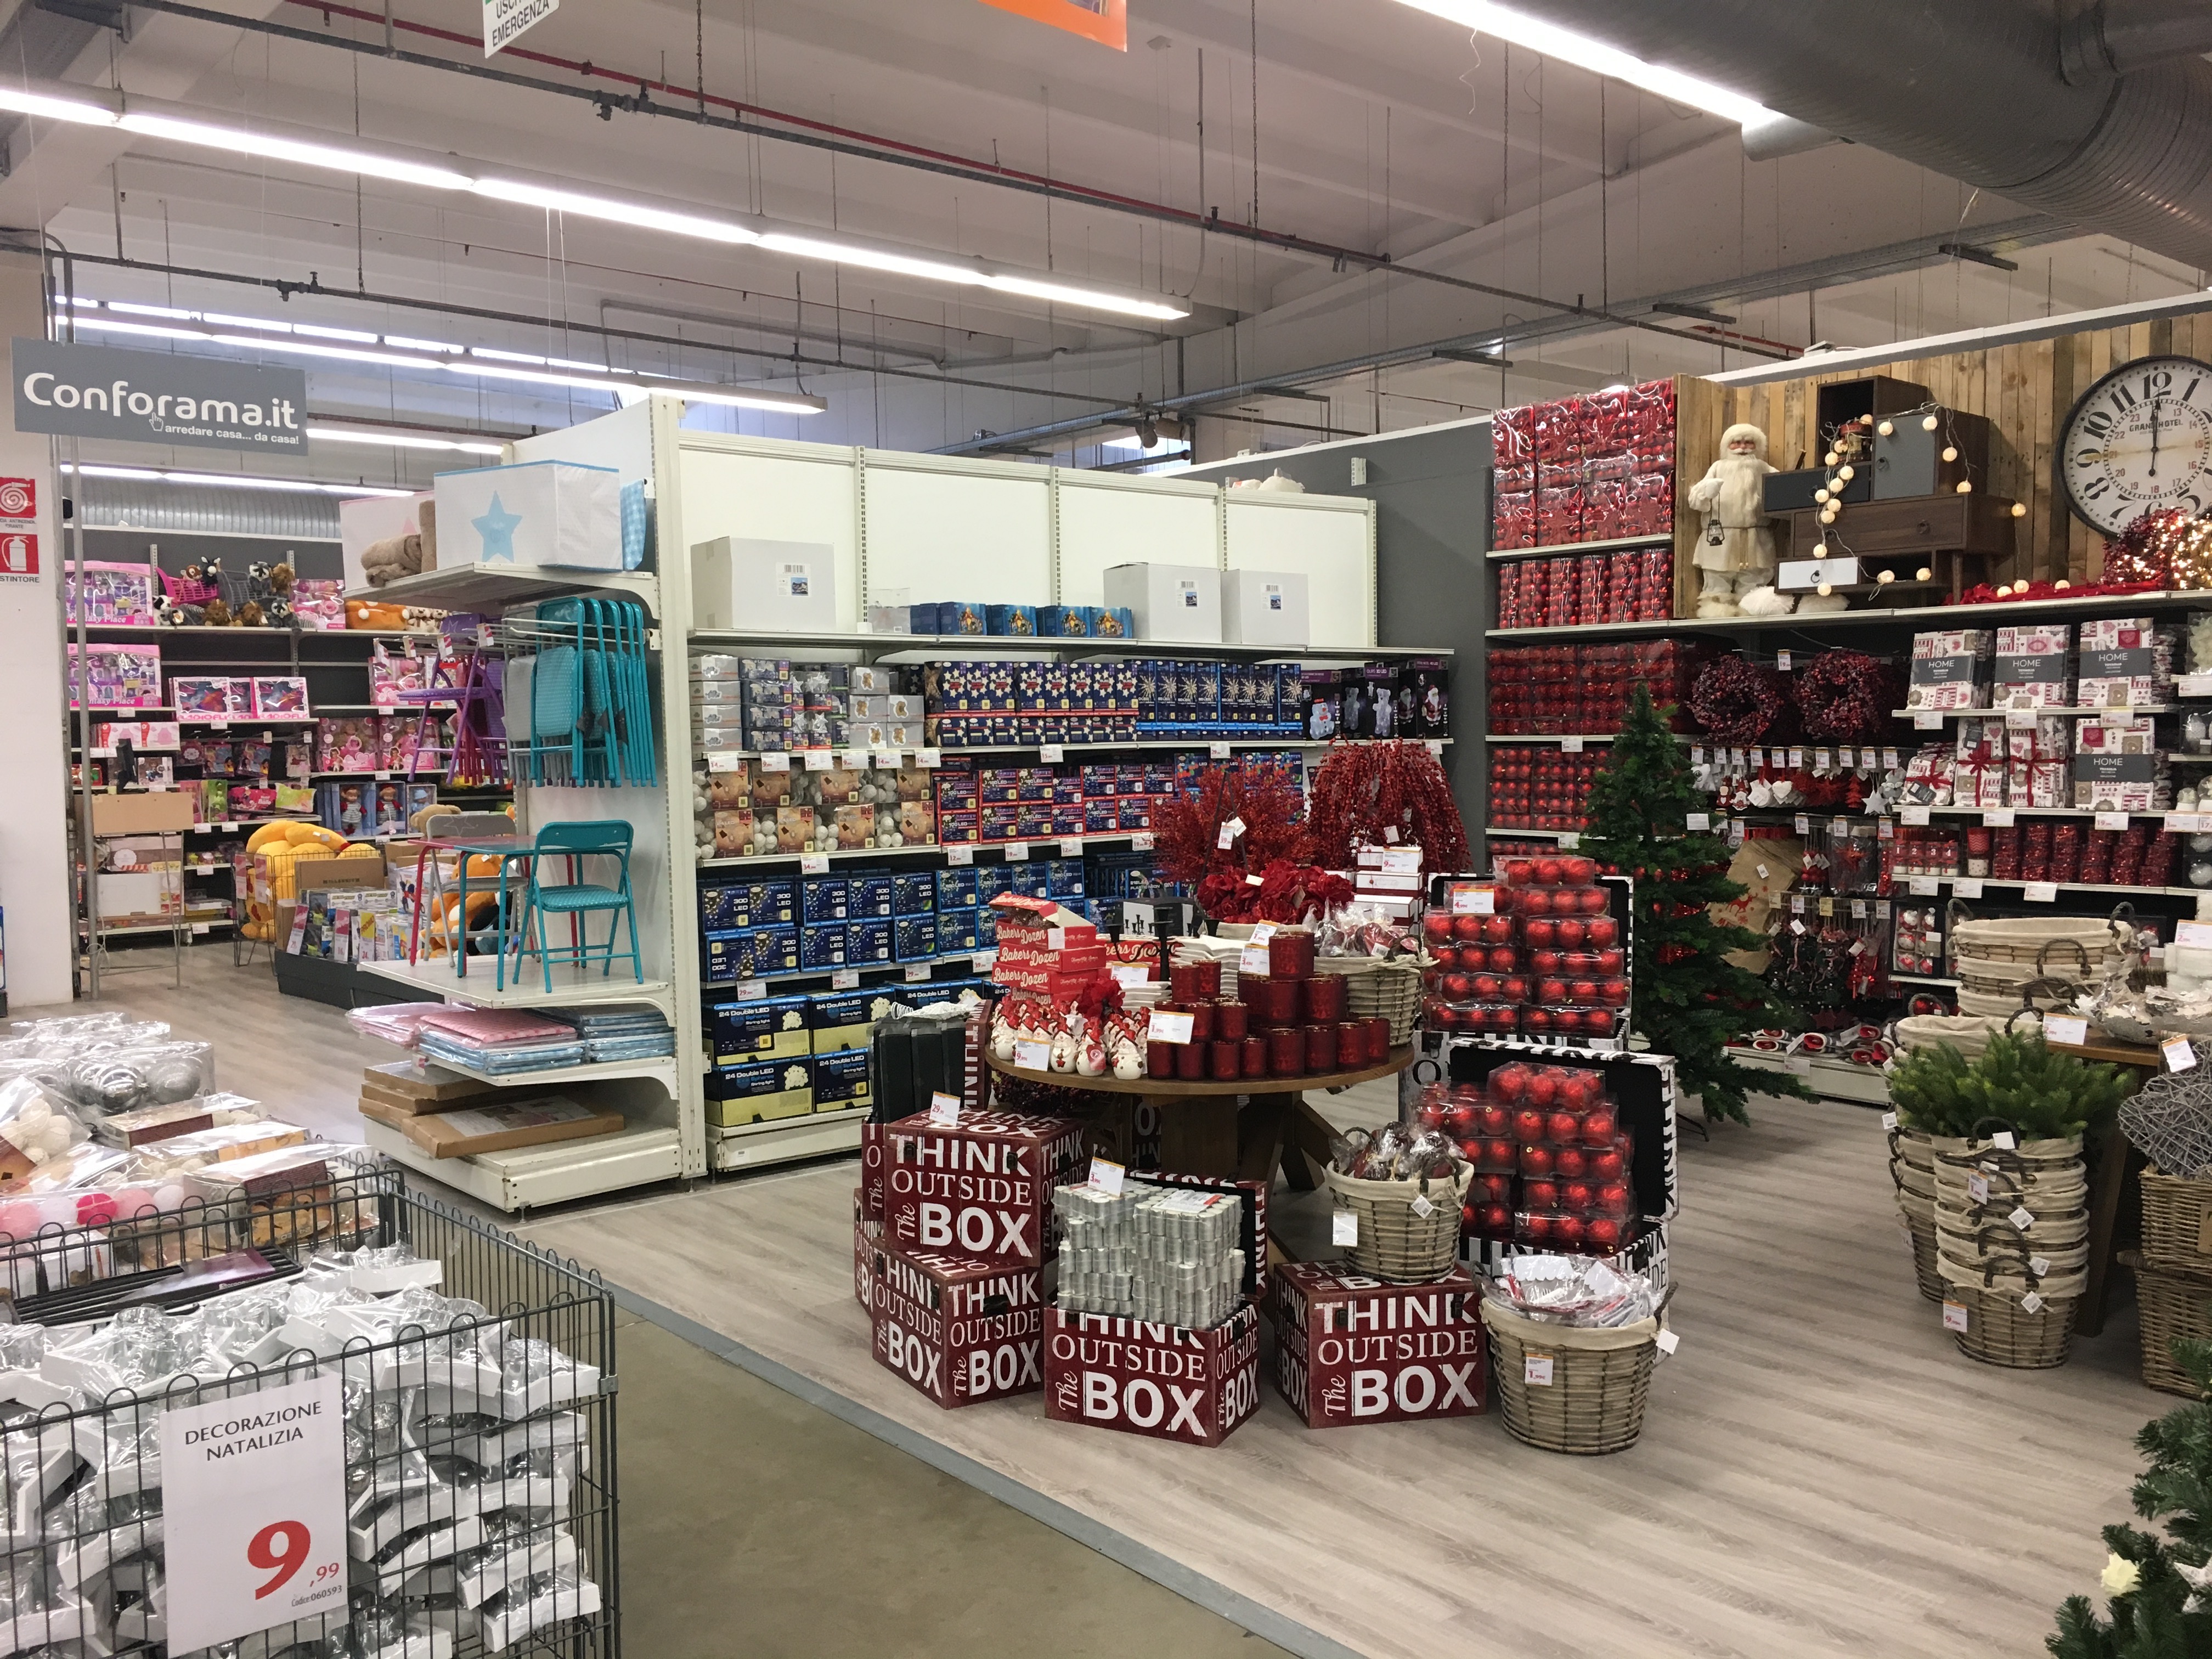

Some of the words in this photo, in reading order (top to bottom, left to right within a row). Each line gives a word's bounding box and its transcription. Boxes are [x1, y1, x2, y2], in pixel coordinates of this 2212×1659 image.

[493, 0, 549, 47] EMERGENZA
[2111, 385, 2136, 414] 11
[2143, 372, 2172, 399] 12
[24, 373, 298, 429] Conforama.it
[2174, 408, 2182, 416] 13
[2084, 411, 2112, 440] 10
[2130, 414, 2140, 422] 23
[2158, 419, 2183, 428] HOTEL
[2190, 420, 2198, 429] 14
[165, 425, 213, 437] arredare
[255, 432, 268, 442] da
[271, 436, 299, 444] casa!
[2195, 439, 2204, 448] 15
[2076, 448, 2101, 468] 9
[2188, 461, 2197, 470] 16
[2115, 469, 2125, 477] 20
[2131, 482, 2138, 490] 19
[2172, 478, 2181, 487] 17
[2084, 477, 2109, 500] 8
[2176, 487, 2201, 515] 5
[2110, 494, 2136, 520] 7
[104, 614, 127, 623] Place
[2013, 659, 2041, 667] HOME
[2098, 653, 2128, 662] HOME
[996, 925, 1021, 939] Bakers
[1020, 929, 1046, 944] Dozen
[1000, 947, 1030, 962] Bakers
[1029, 950, 1060, 966] Dozen
[993, 967, 1022, 983] Bakers
[1020, 972, 1048, 987] Dozen
[889, 1134, 1032, 1177] THINK
[891, 1169, 1032, 1206] OUTSIDE
[894, 1202, 915, 1240] The
[920, 1201, 1032, 1257] BOX
[874, 1248, 942, 1316] THINK
[947, 1272, 1040, 1317] THINK
[876, 1283, 942, 1346] OUTSIDE
[950, 1308, 1041, 1347] OUTSIDE
[1314, 1292, 1477, 1334] THINK
[888, 1320, 943, 1398] BOX
[1052, 1334, 1206, 1382] OUTSIDE
[1318, 1330, 1478, 1365] OUTSIDE
[952, 1356, 967, 1397] The
[969, 1339, 1041, 1396] BOX
[1282, 1347, 1308, 1418] BOX
[1056, 1370, 1078, 1411] The
[1083, 1370, 1207, 1438] BOX
[1225, 1358, 1259, 1429] BOX
[1322, 1374, 1346, 1417] The
[1351, 1362, 1479, 1417] BOX
[185, 1401, 322, 1446] DECORAZIONE
[207, 1427, 303, 1462] NATALIZIA
